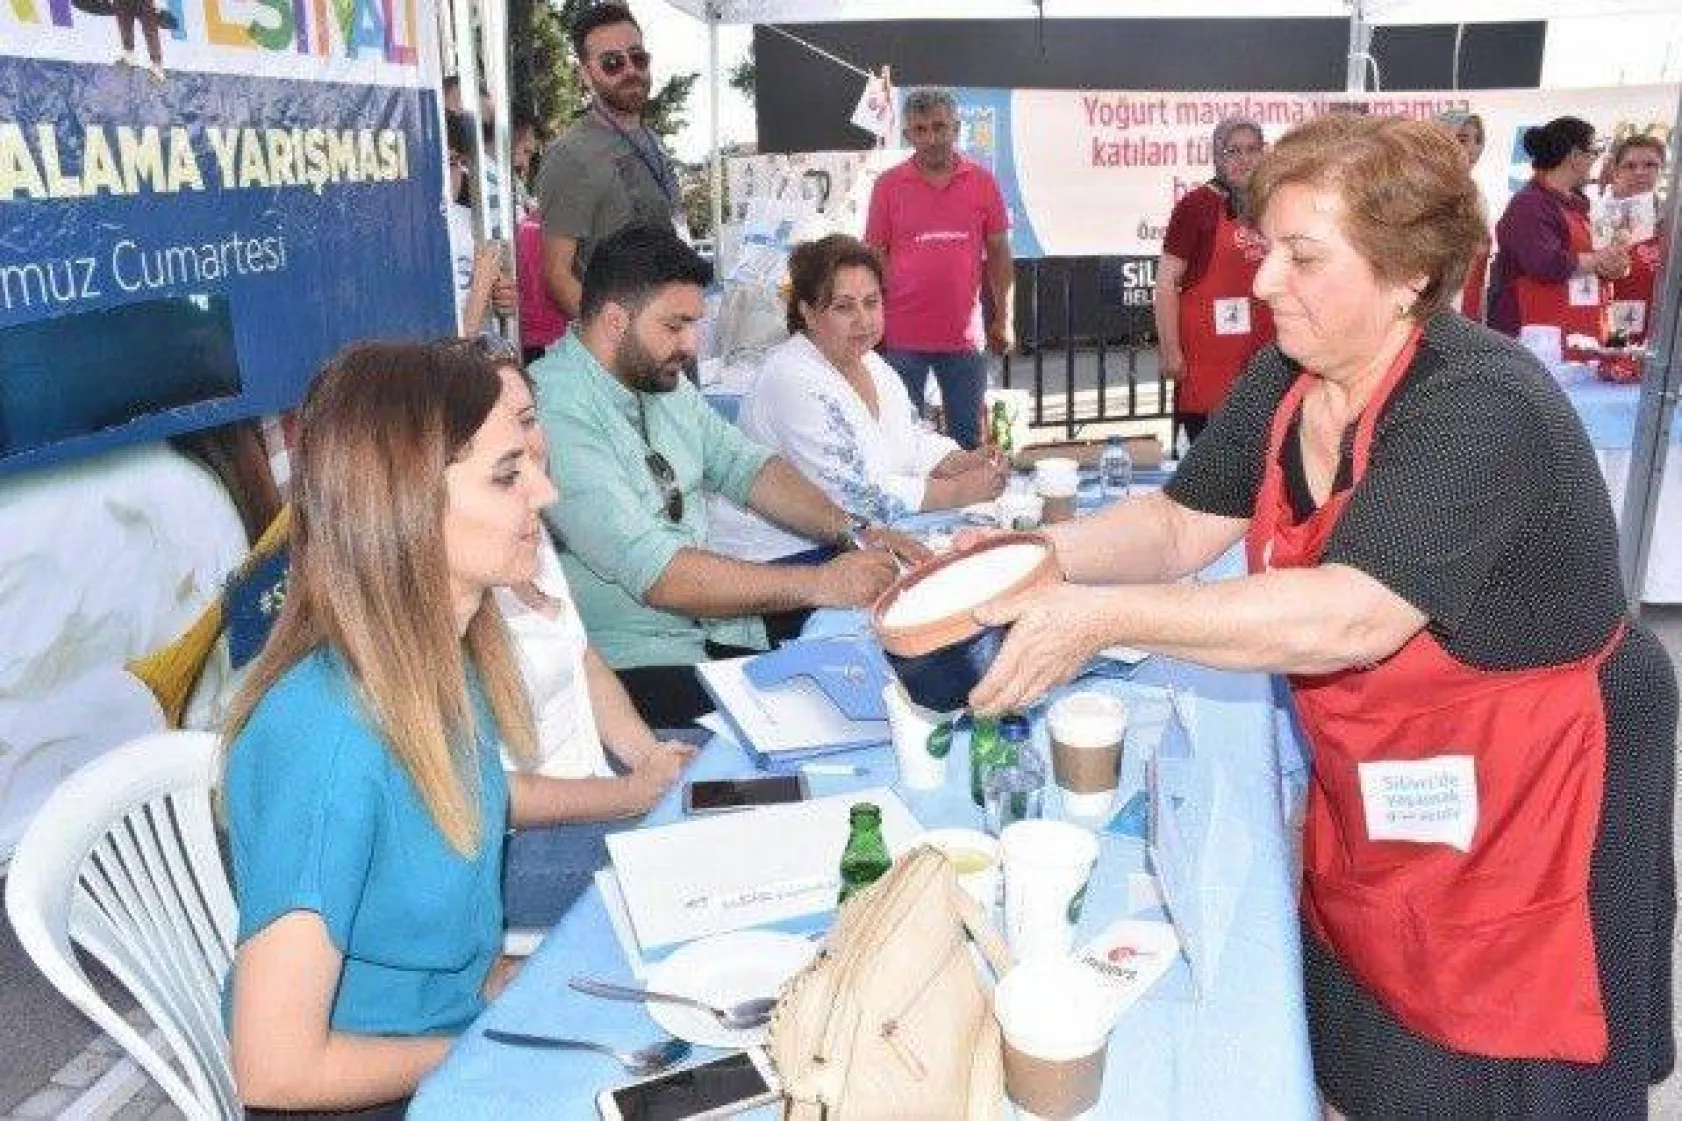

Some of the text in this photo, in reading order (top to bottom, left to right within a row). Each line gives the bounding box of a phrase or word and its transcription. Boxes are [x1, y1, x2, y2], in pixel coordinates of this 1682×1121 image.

[206, 127, 409, 196] YARIŞMASI
[1092, 136, 1178, 167] katılan
[112, 224, 287, 291] Cumartesi
